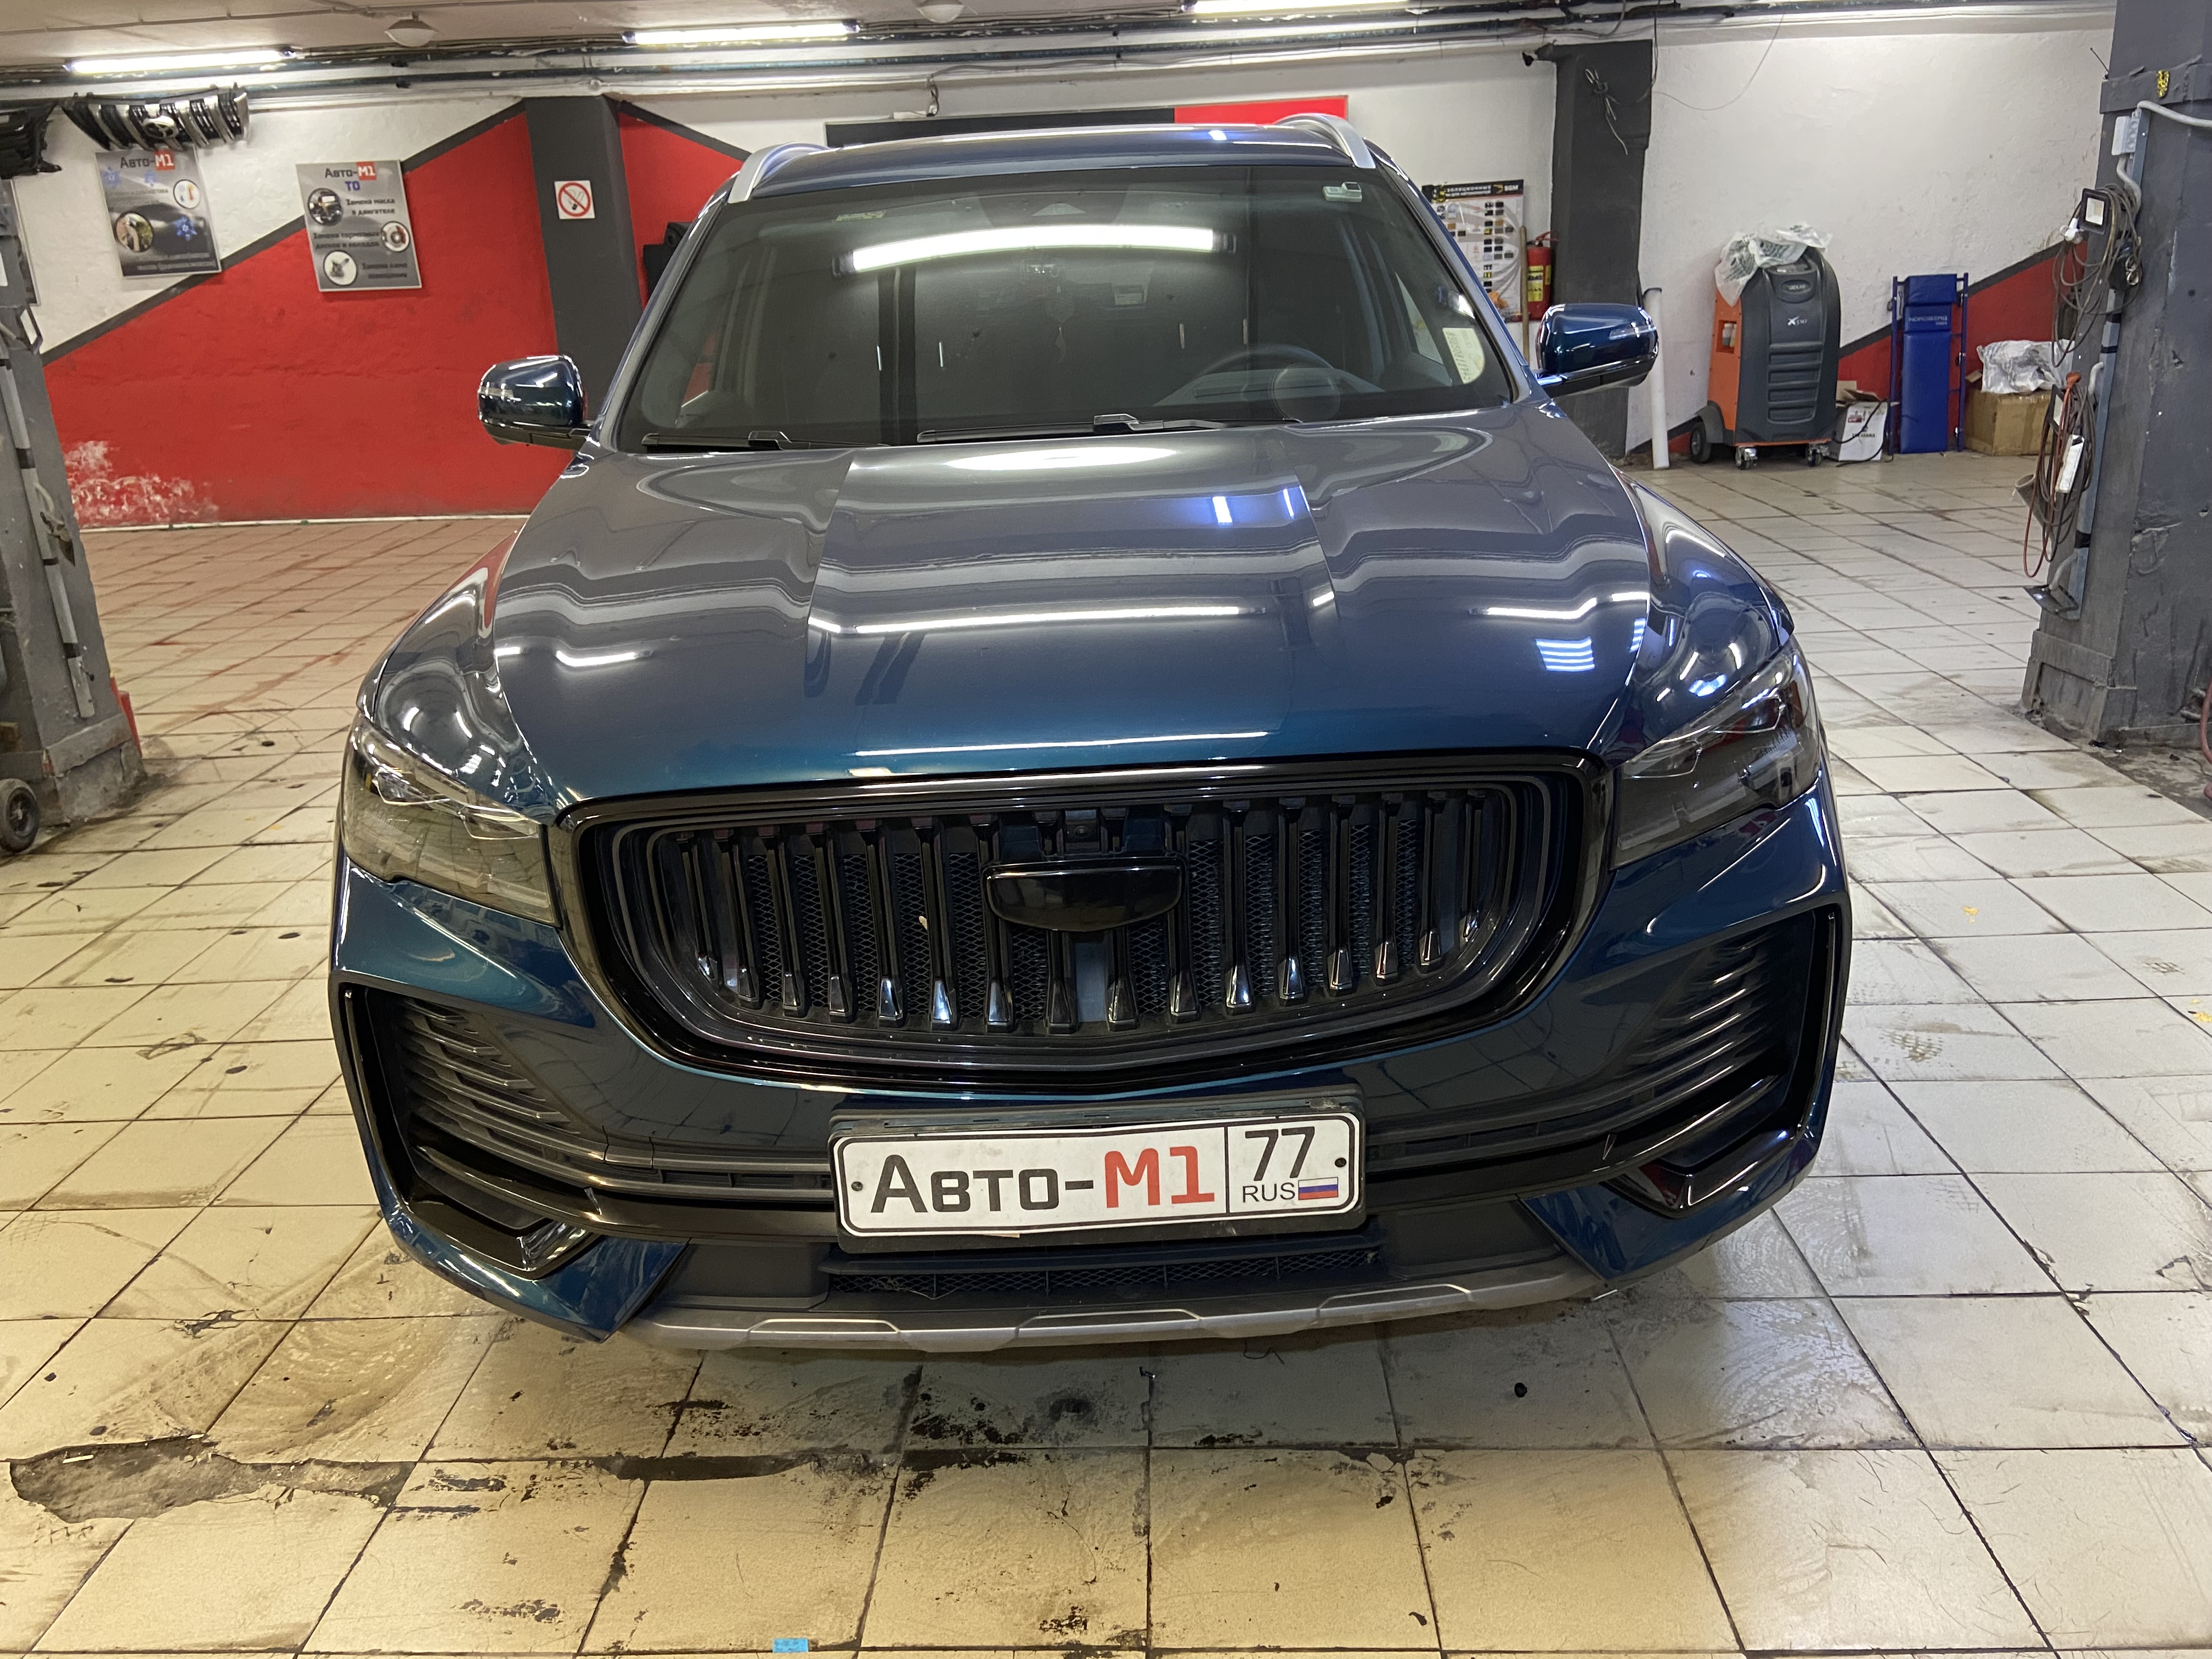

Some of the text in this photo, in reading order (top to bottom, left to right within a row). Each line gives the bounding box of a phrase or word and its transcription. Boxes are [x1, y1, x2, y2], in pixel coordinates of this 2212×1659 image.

[120, 154, 174, 169] Авто-М1
[325, 165, 376, 178] Авто-М1
[345, 180, 360, 191] ТО
[1245, 1126, 1316, 1182] 77
[870, 1146, 1215, 1214] Авто-М1
[1242, 1182, 1296, 1204] RUS
